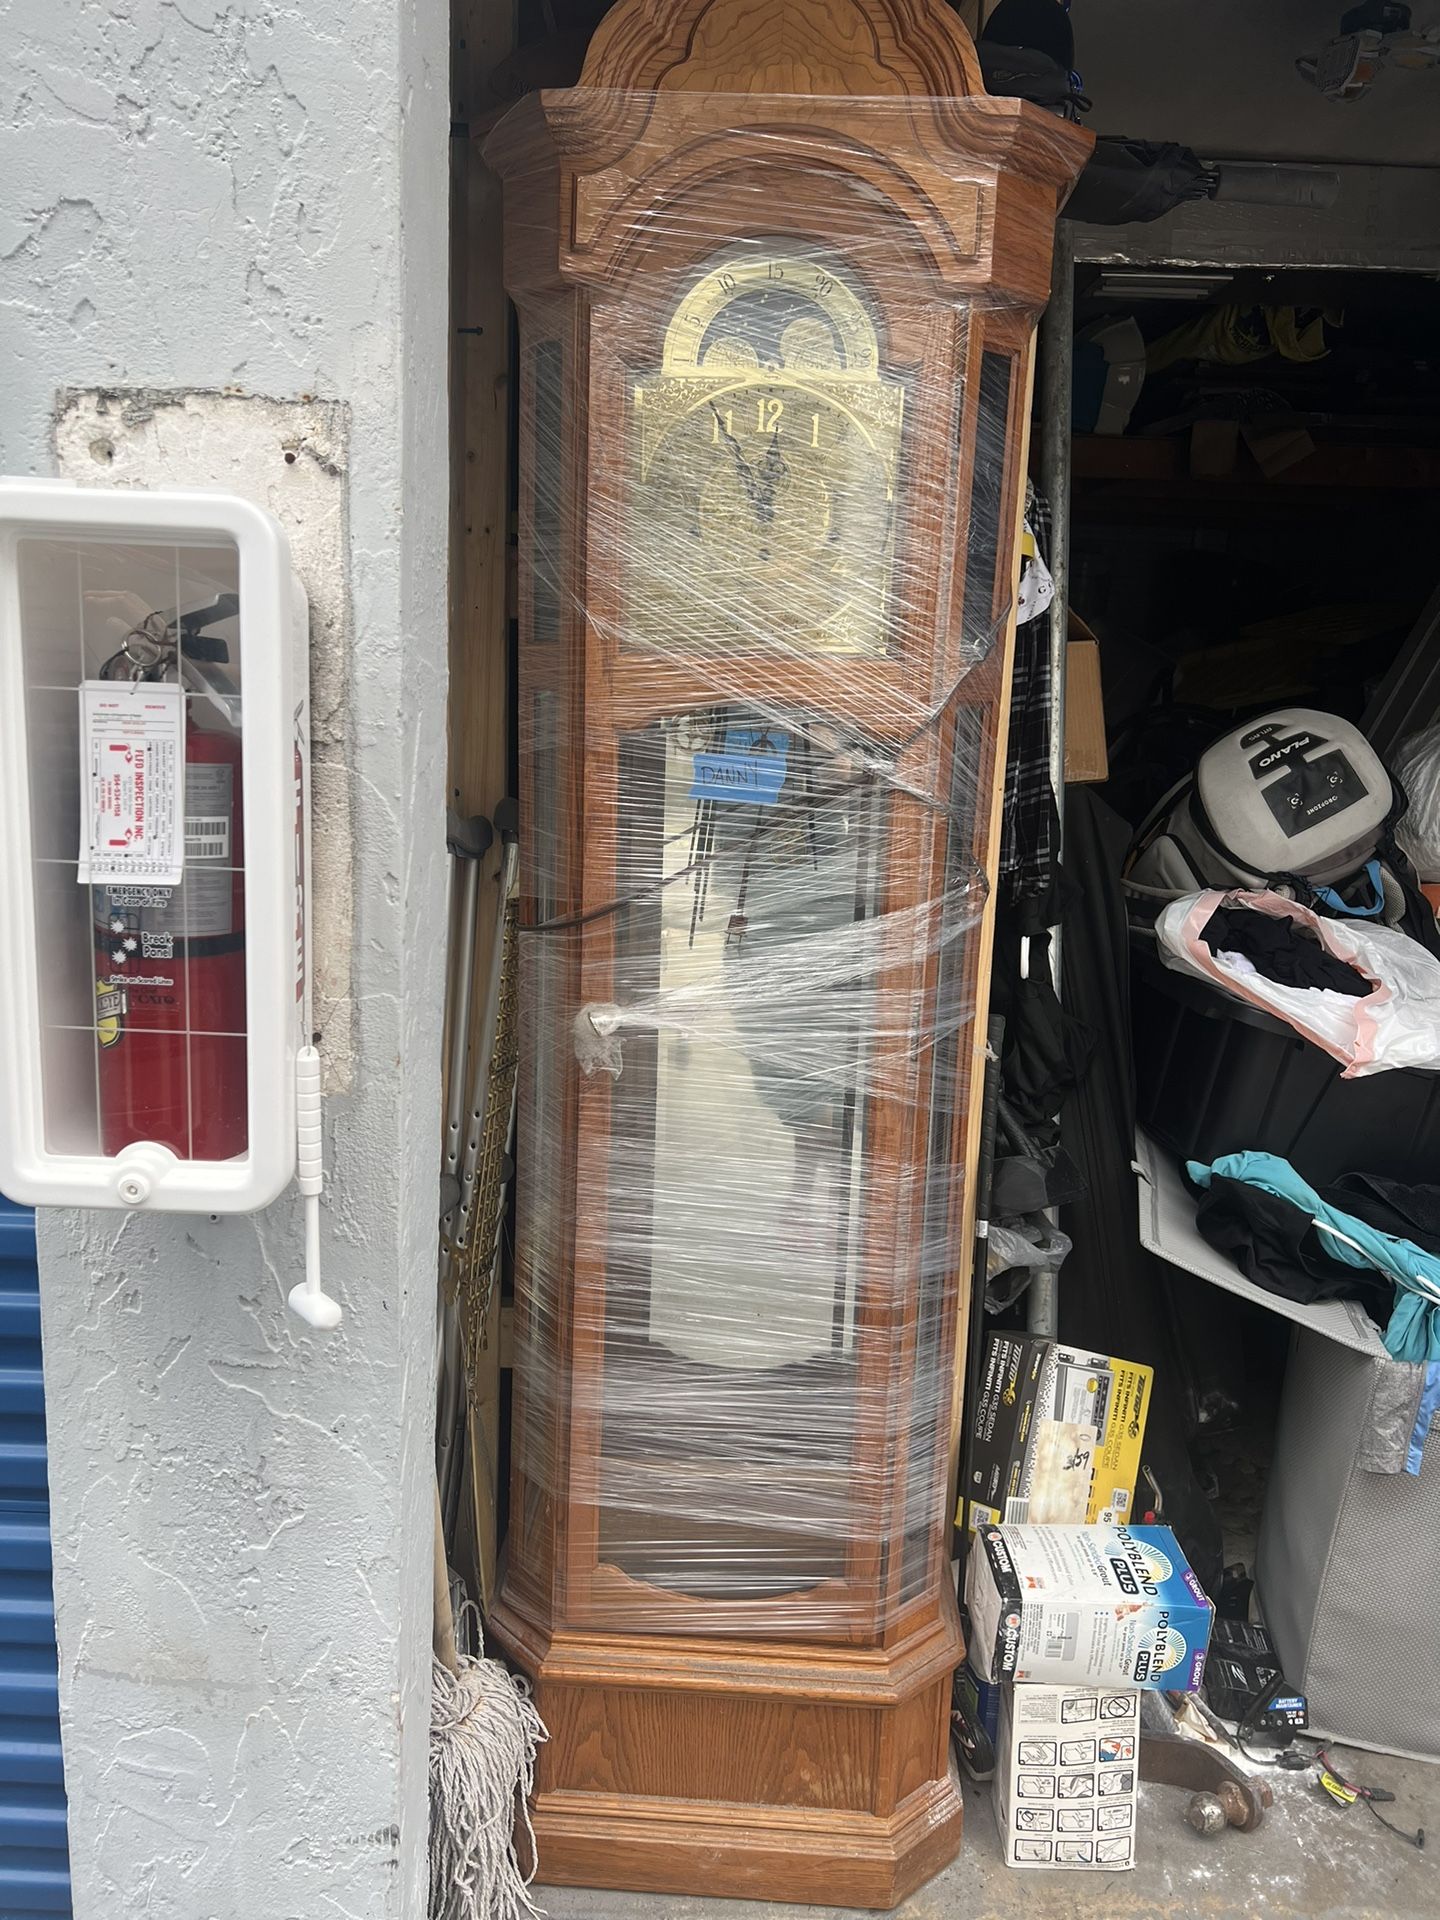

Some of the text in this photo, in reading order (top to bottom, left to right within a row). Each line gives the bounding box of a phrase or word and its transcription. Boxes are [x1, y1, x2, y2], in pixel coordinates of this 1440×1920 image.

[717, 272, 736, 295] 10
[767, 262, 784, 281] 15
[757, 398, 784, 433] 12
[810, 413, 820, 447] 1
[1259, 736, 1310, 767] PLANO
[134, 772, 144, 823] INSPECTION
[107, 886, 171, 898] EMERGENCY ONLY
[142, 932, 173, 944] Break
[143, 945, 172, 957] Panel
[991, 1338, 1000, 1357] FITS
[1001, 1340, 1009, 1359] FITS
[985, 1357, 996, 1390] INFINITI
[995, 1360, 1006, 1393] INFINITI
[1126, 1371, 1134, 1389] FITS
[1112, 1388, 1122, 1421] INFINITI
[1120, 1390, 1130, 1423] INFINITI
[976, 1408, 987, 1439] COUPE
[985, 1412, 996, 1442] SEDAN
[1103, 1512, 1112, 1523] 95
[992, 1540, 1012, 1573] CUSTOM
[1112, 1526, 1158, 1596] POLYBLEND
[1097, 1564, 1112, 1587] Grout
[1113, 1560, 1136, 1594] PLUS
[1188, 1579, 1205, 1601] GROUT
[1002, 1628, 1019, 1671] CUSTOM
[1150, 1611, 1169, 1682] POLYBLEND
[1121, 1658, 1132, 1676] Grout
[1135, 1652, 1149, 1681] PLUS
[1192, 1661, 1203, 1687] GROUT
